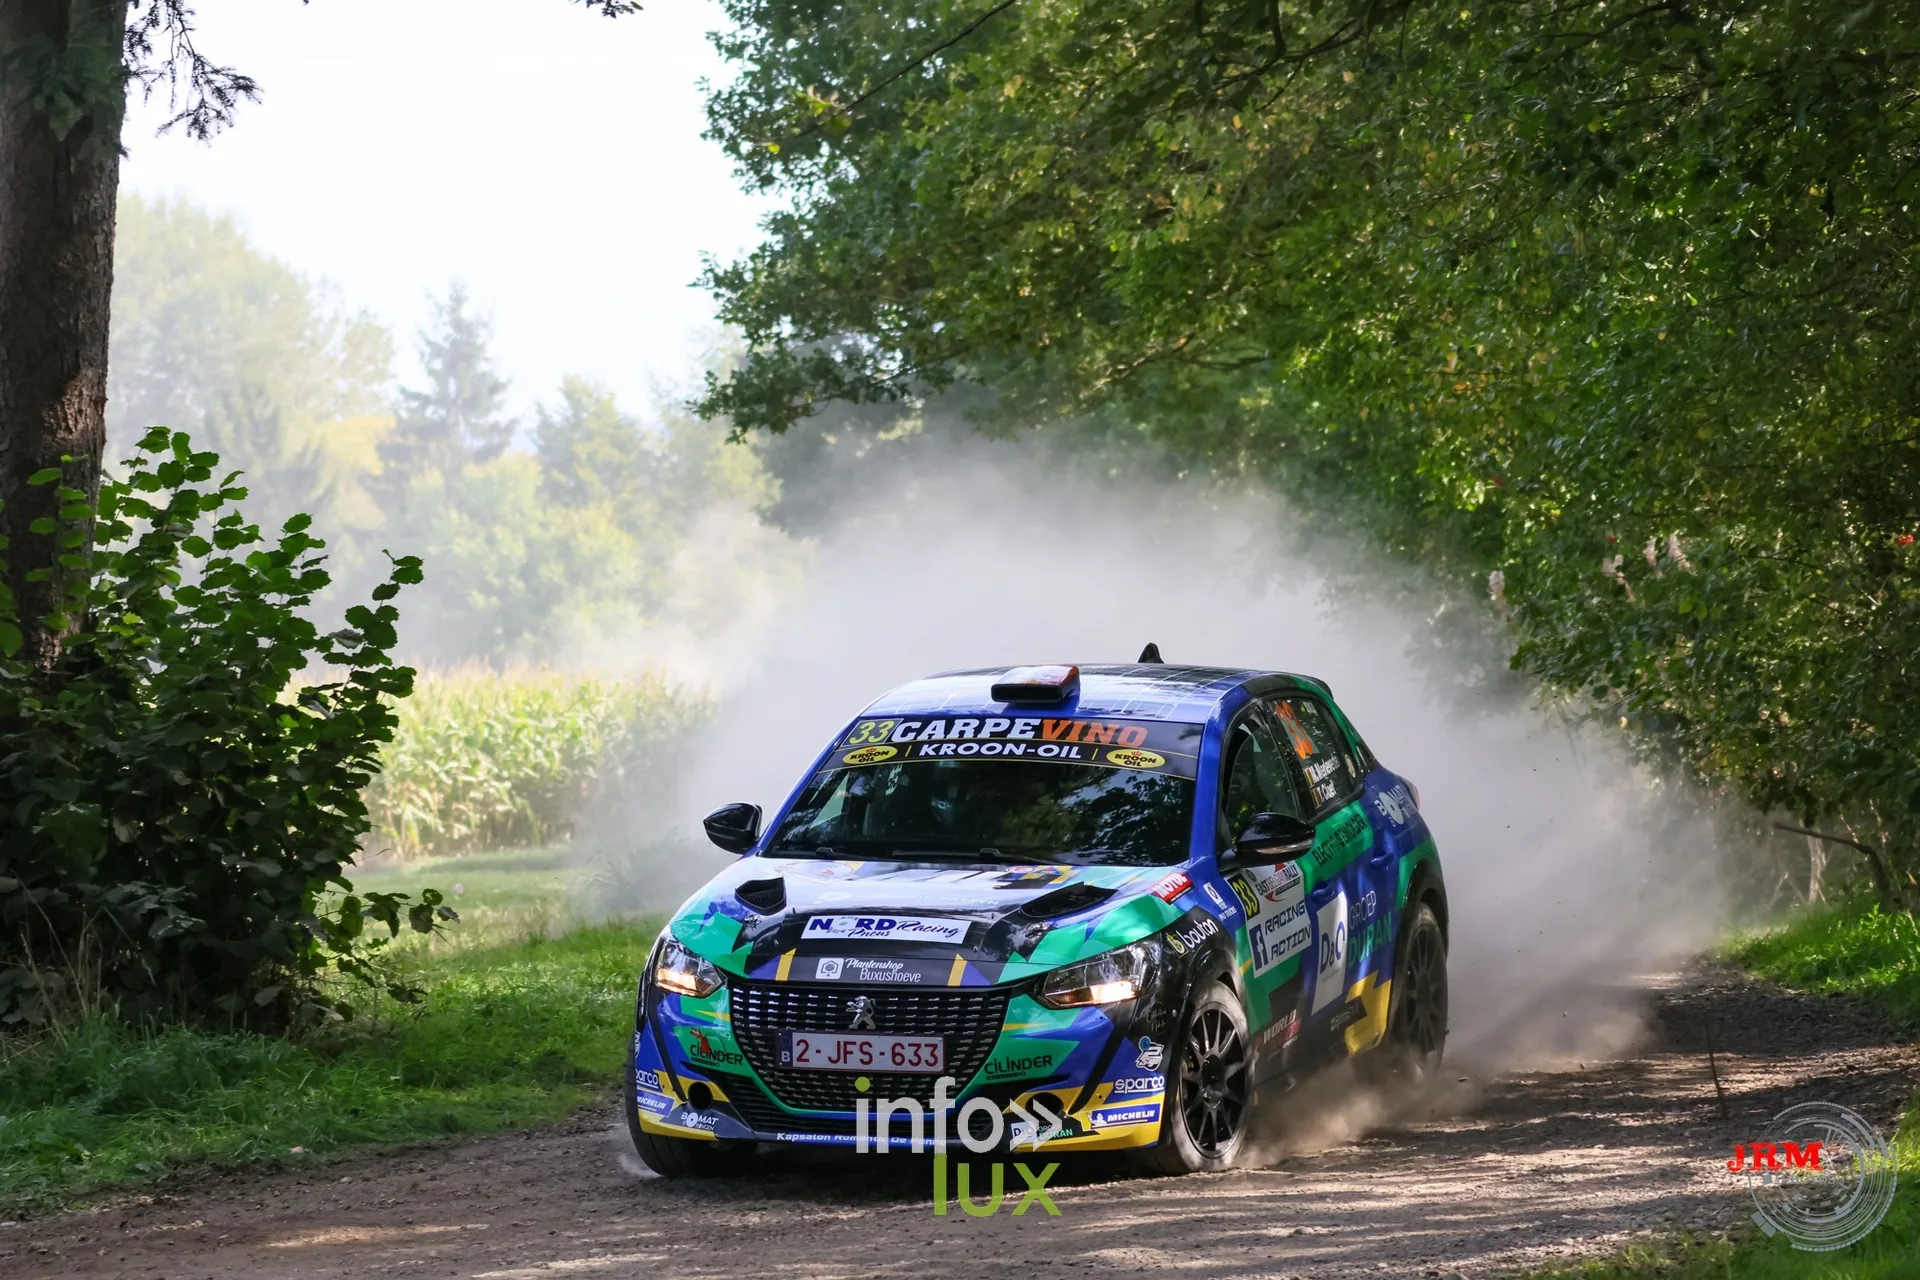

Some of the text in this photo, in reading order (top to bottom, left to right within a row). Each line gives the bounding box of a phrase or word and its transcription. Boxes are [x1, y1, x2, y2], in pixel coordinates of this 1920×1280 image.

[850, 718, 1148, 747] 33 CARPEVINO
[850, 750, 890, 762] KROON
[919, 743, 1081, 759] KROON-OIL
[1114, 753, 1157, 764] KROON
[1132, 759, 1142, 767] OIL
[1151, 872, 1188, 898] MOTUL
[1233, 879, 1259, 917] 33
[1265, 902, 1305, 935] RACING
[1350, 890, 1377, 930] GROEP
[896, 920, 961, 938] Racing
[1176, 919, 1218, 949] bouton
[1271, 924, 1310, 960] ACTION
[1350, 914, 1391, 968] DURAN
[844, 957, 904, 970] Plantenshop
[859, 968, 921, 983] Buxushoeve
[782, 1051, 790, 1062] B
[1115, 1075, 1164, 1093] sparco
[1107, 1109, 1155, 1122] MICHELIN
[777, 1132, 830, 1142] Kapsalon
